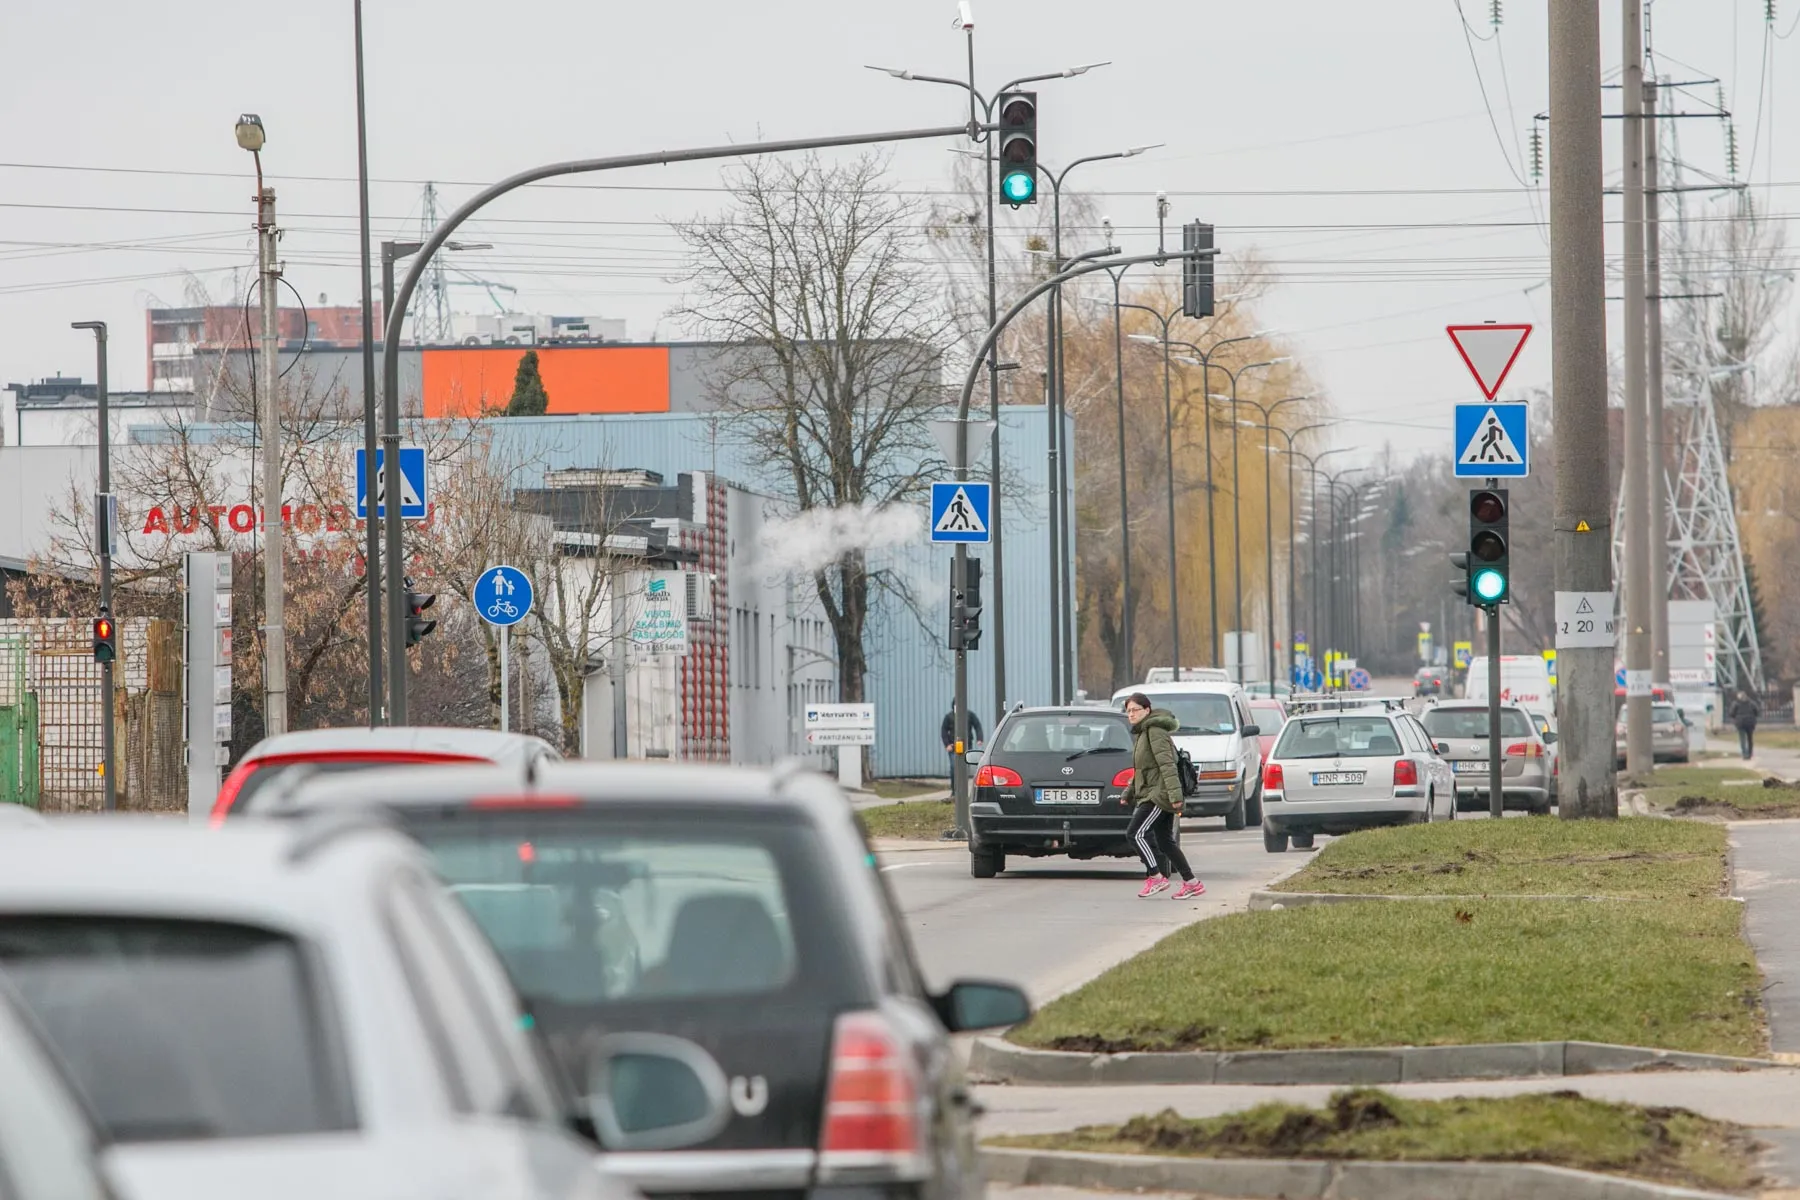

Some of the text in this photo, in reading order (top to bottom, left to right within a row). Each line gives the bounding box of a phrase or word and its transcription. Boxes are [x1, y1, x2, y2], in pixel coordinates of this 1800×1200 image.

[1577, 620, 1594, 633] 20
[1345, 773, 1362, 782] 509
[1044, 790, 1068, 800] ETB
[1076, 790, 1097, 800] 835
